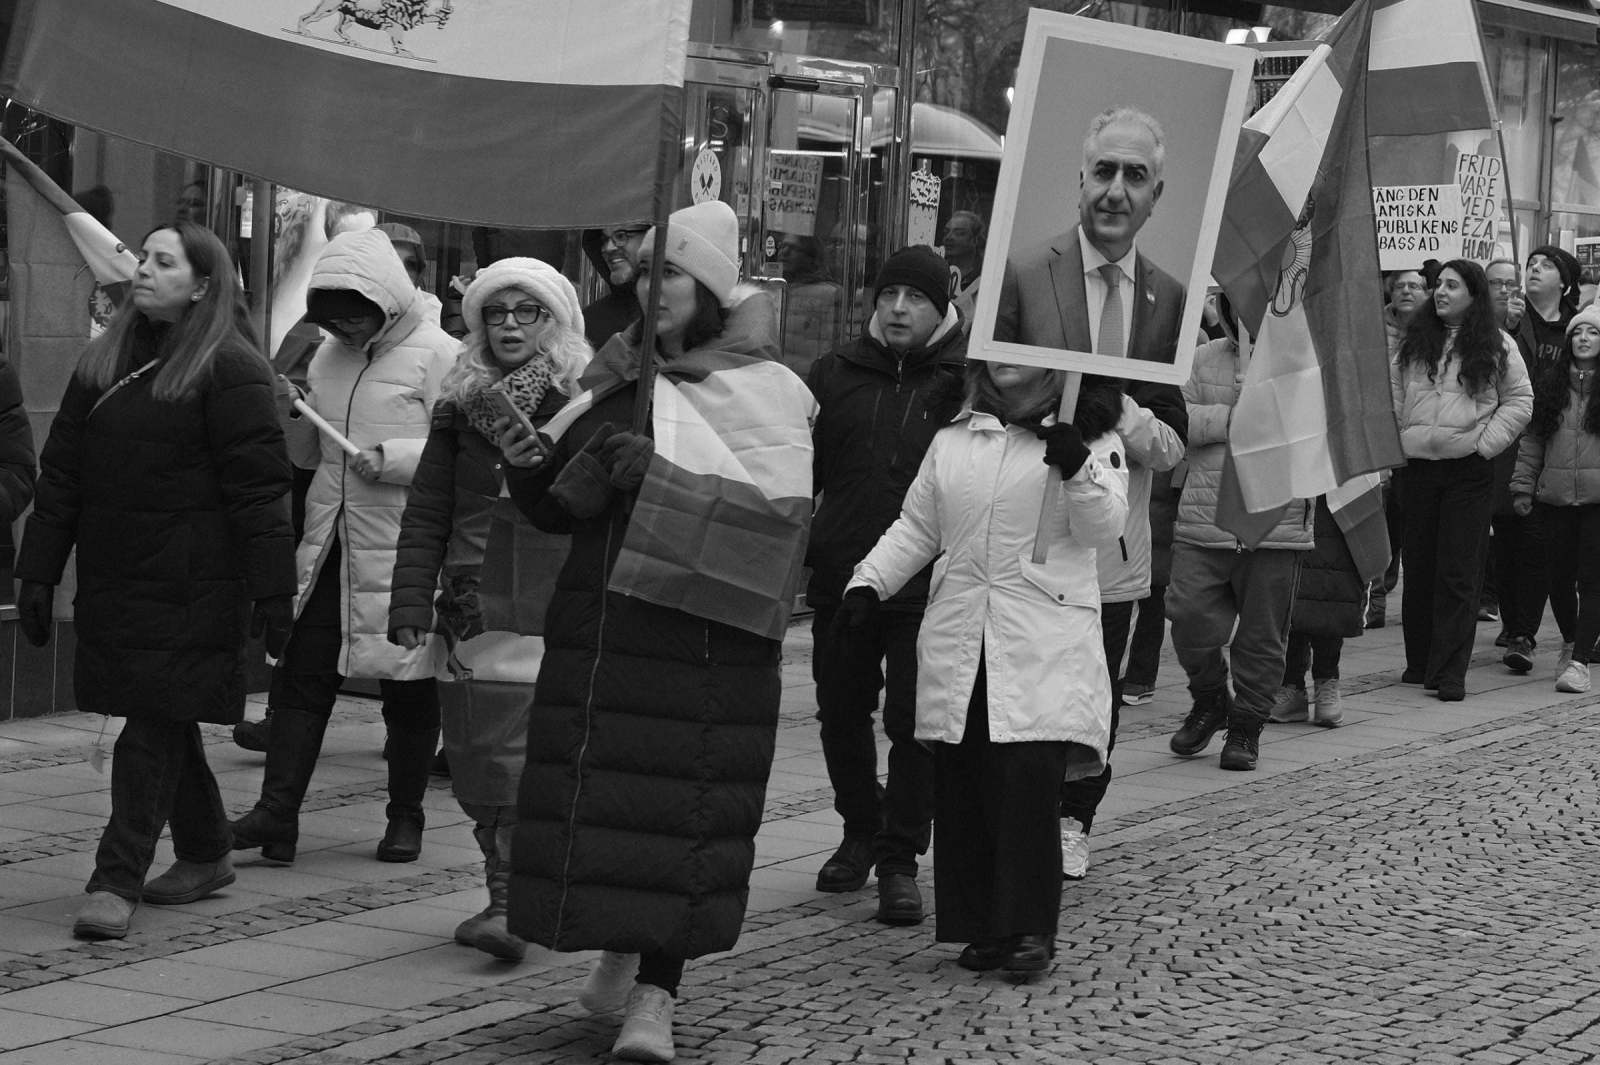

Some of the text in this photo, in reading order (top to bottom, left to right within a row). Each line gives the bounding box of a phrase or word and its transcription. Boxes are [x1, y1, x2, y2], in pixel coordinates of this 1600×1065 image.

[1459, 153, 1501, 177] FRID
[1459, 173, 1497, 198] VARE
[1408, 187, 1439, 202] DEN
[1379, 203, 1436, 217] AMISKA
[1377, 219, 1458, 234] PUBLIKENS
[1379, 236, 1439, 251] BASSAD
